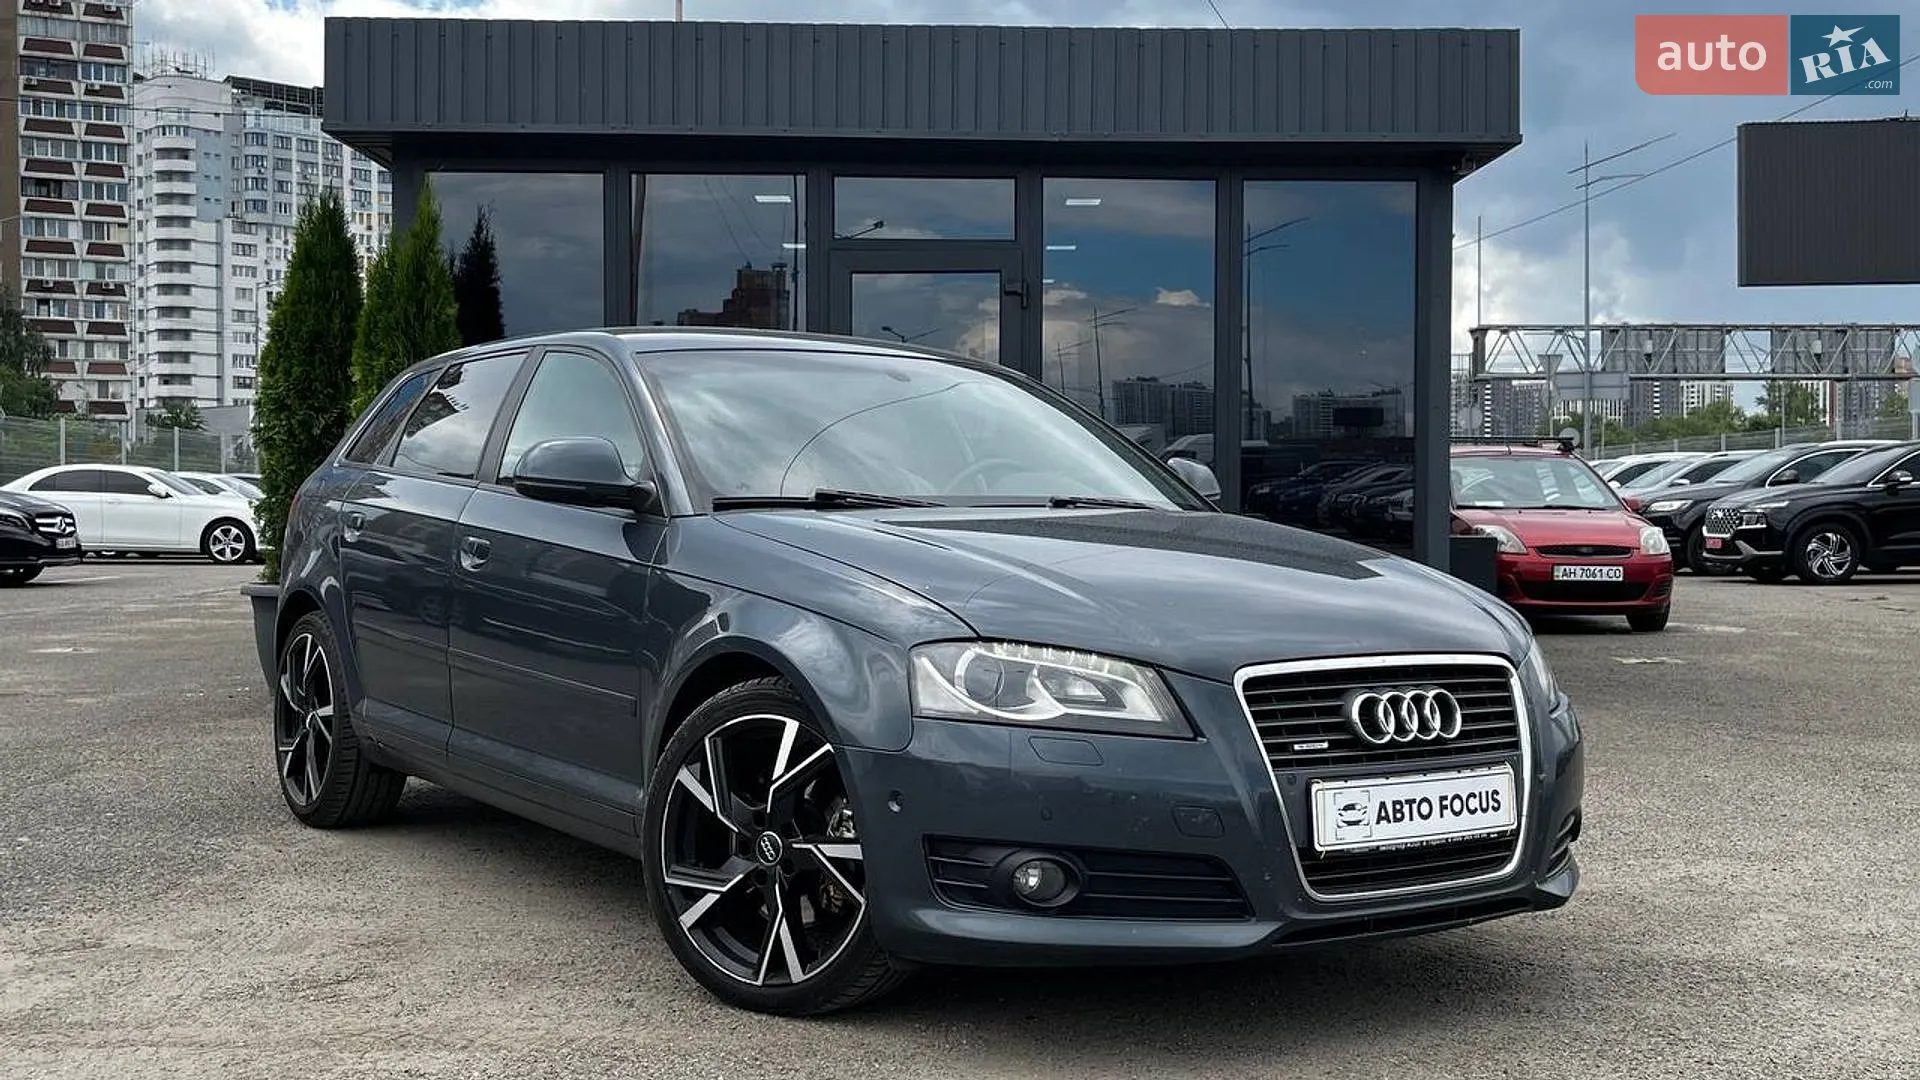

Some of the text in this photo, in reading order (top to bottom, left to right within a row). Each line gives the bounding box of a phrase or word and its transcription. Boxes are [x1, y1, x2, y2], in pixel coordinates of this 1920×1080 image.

[1561, 568, 1621, 579] AH 7061 CO
[1375, 789, 1501, 825] АВТО FOCUS
